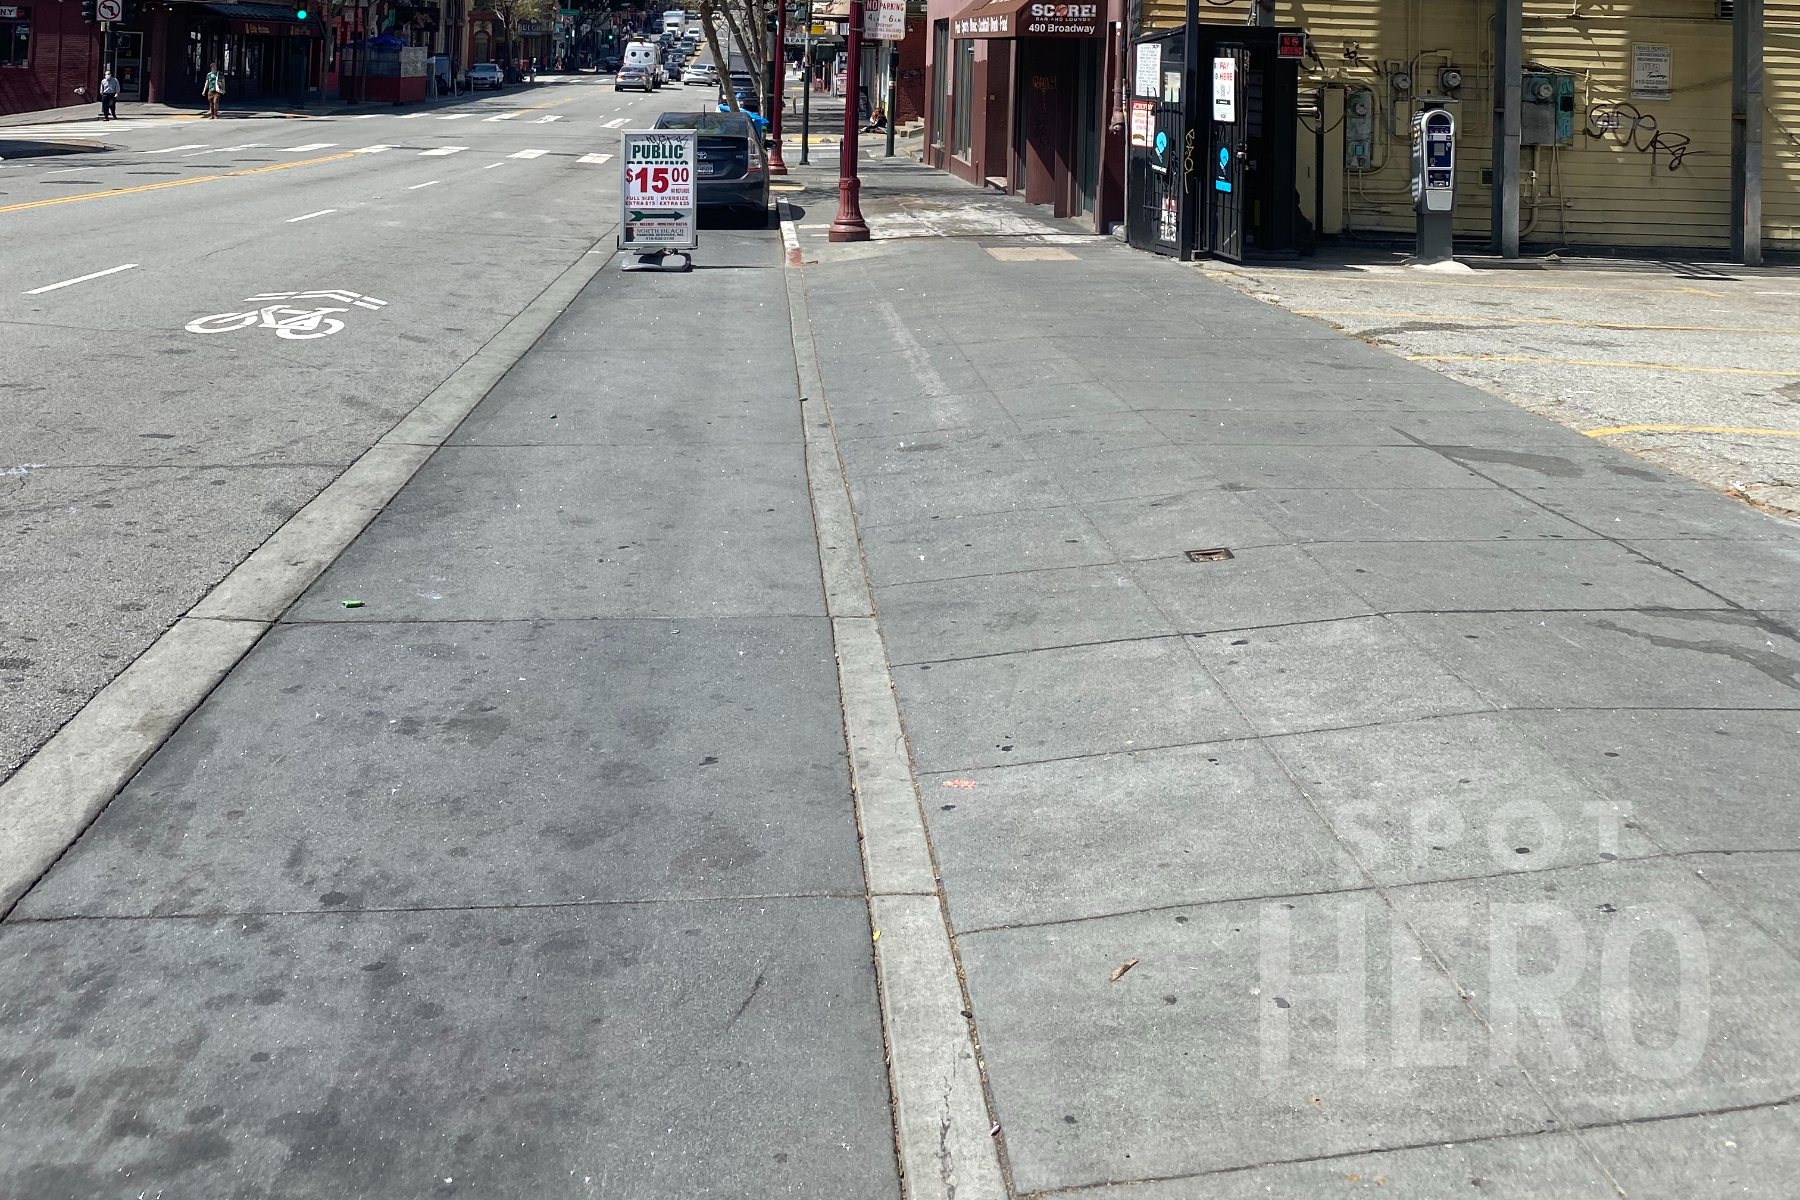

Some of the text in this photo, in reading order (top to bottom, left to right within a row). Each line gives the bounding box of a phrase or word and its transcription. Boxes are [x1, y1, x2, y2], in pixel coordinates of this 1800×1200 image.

[867, 0, 904, 11] NO PARKING
[888, 14, 894, 23] 6
[1028, 23, 1095, 35] 490 Broadway
[1220, 61, 1229, 70] PAY
[1220, 72, 1233, 81] HERE
[632, 144, 684, 159] PUBLIC
